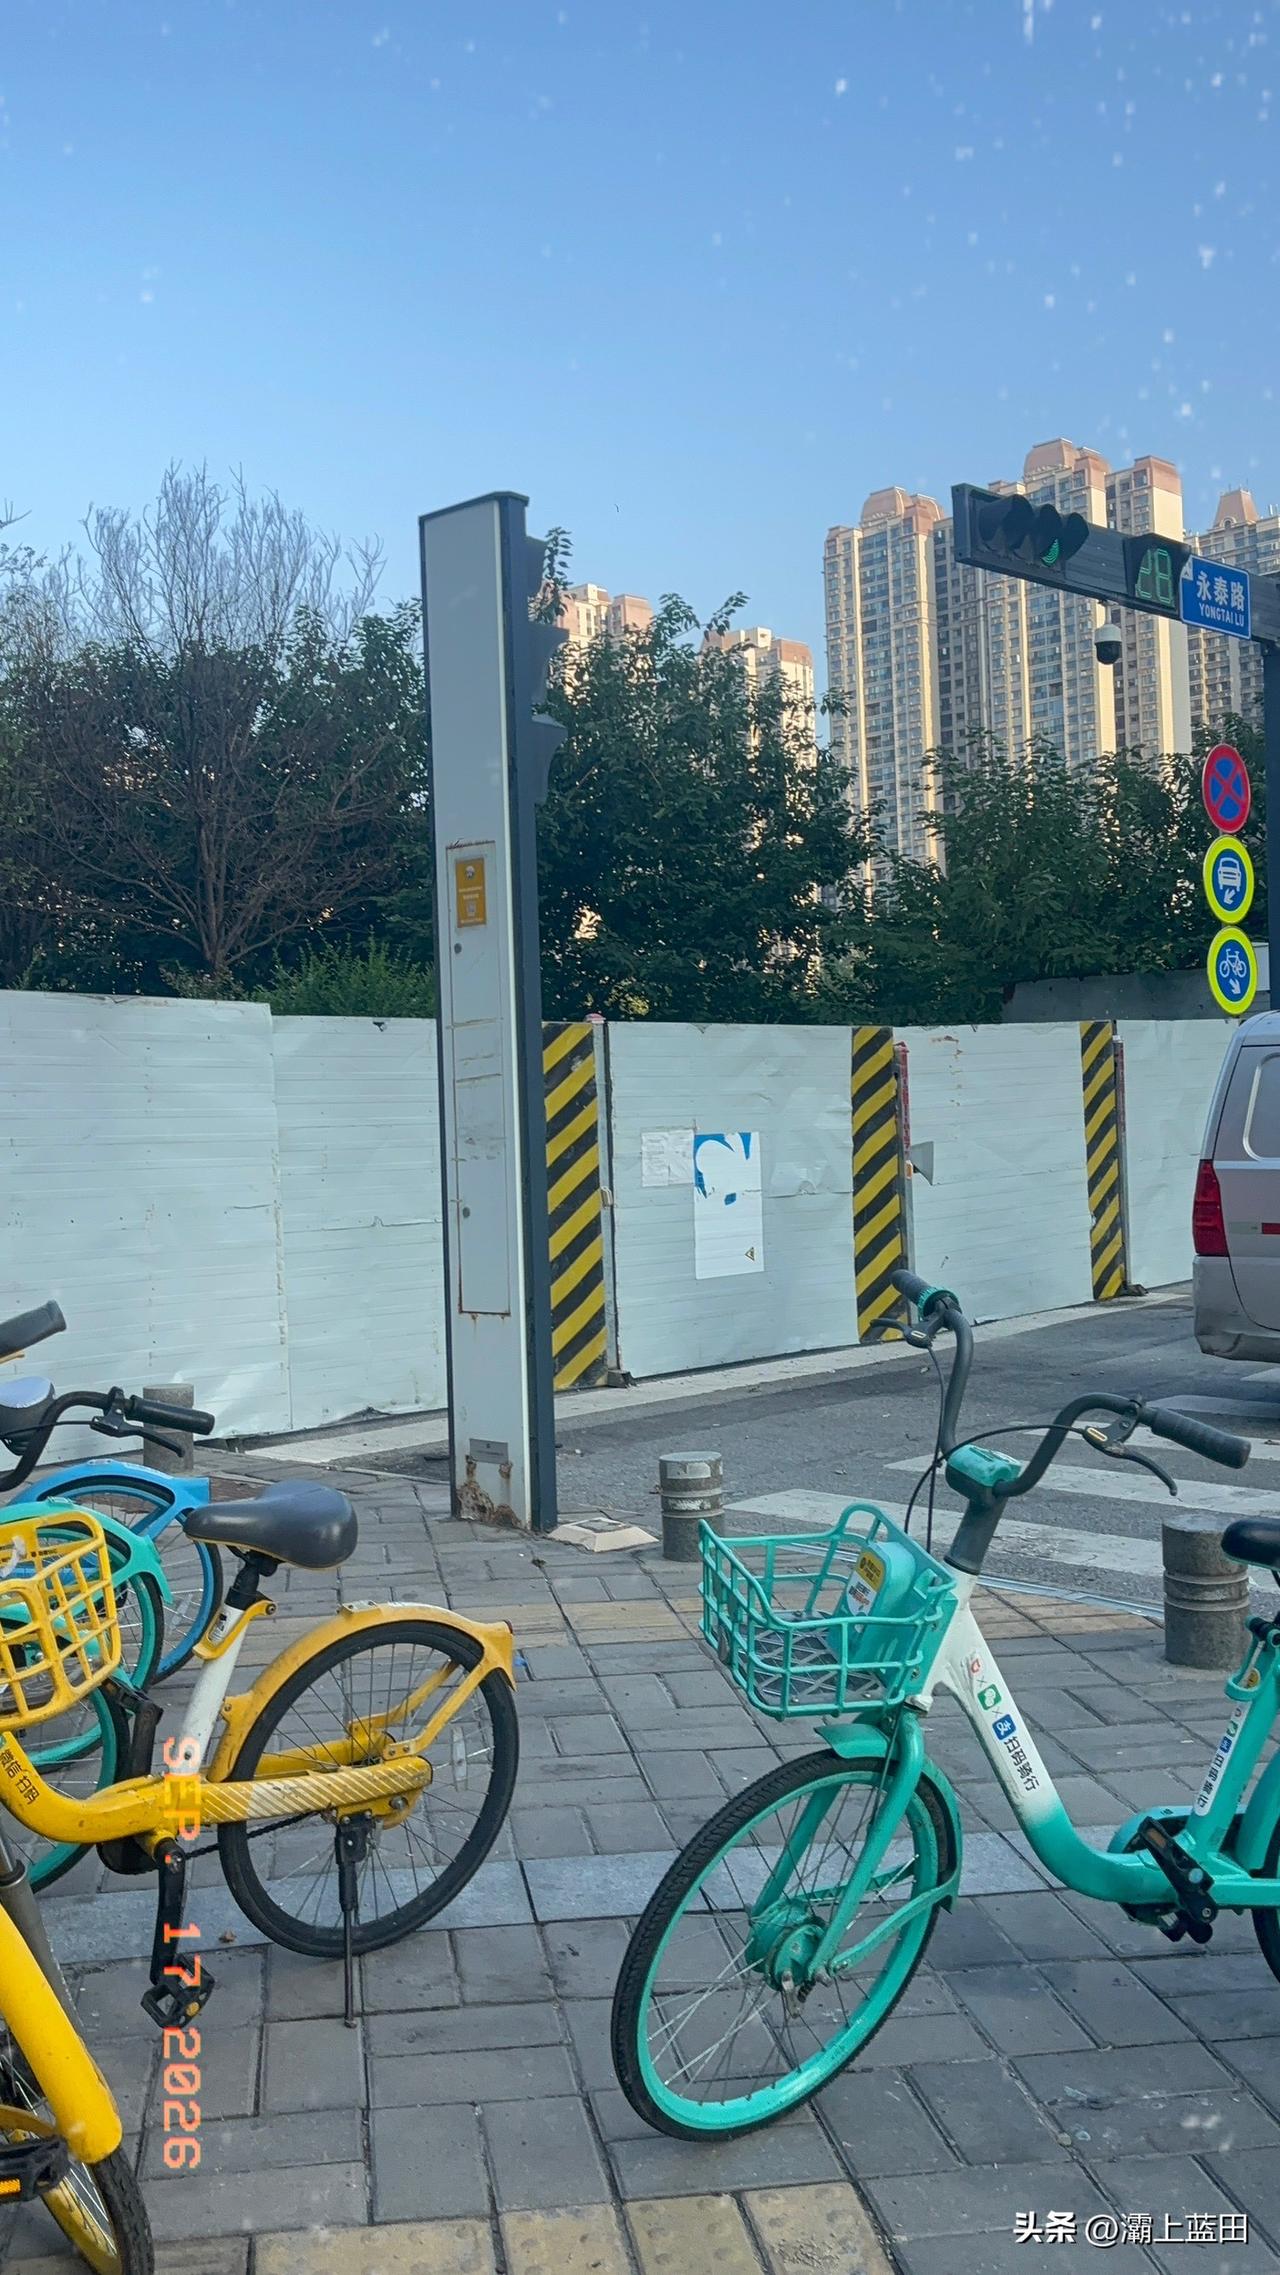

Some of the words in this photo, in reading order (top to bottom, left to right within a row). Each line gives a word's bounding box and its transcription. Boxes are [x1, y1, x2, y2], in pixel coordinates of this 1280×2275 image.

[1196, 570, 1245, 611] 永泰路
[1199, 602, 1233, 624] YONGTAI
[1235, 611, 1245, 627] LU
[1004, 1736, 1039, 1791] 扫码骑行
